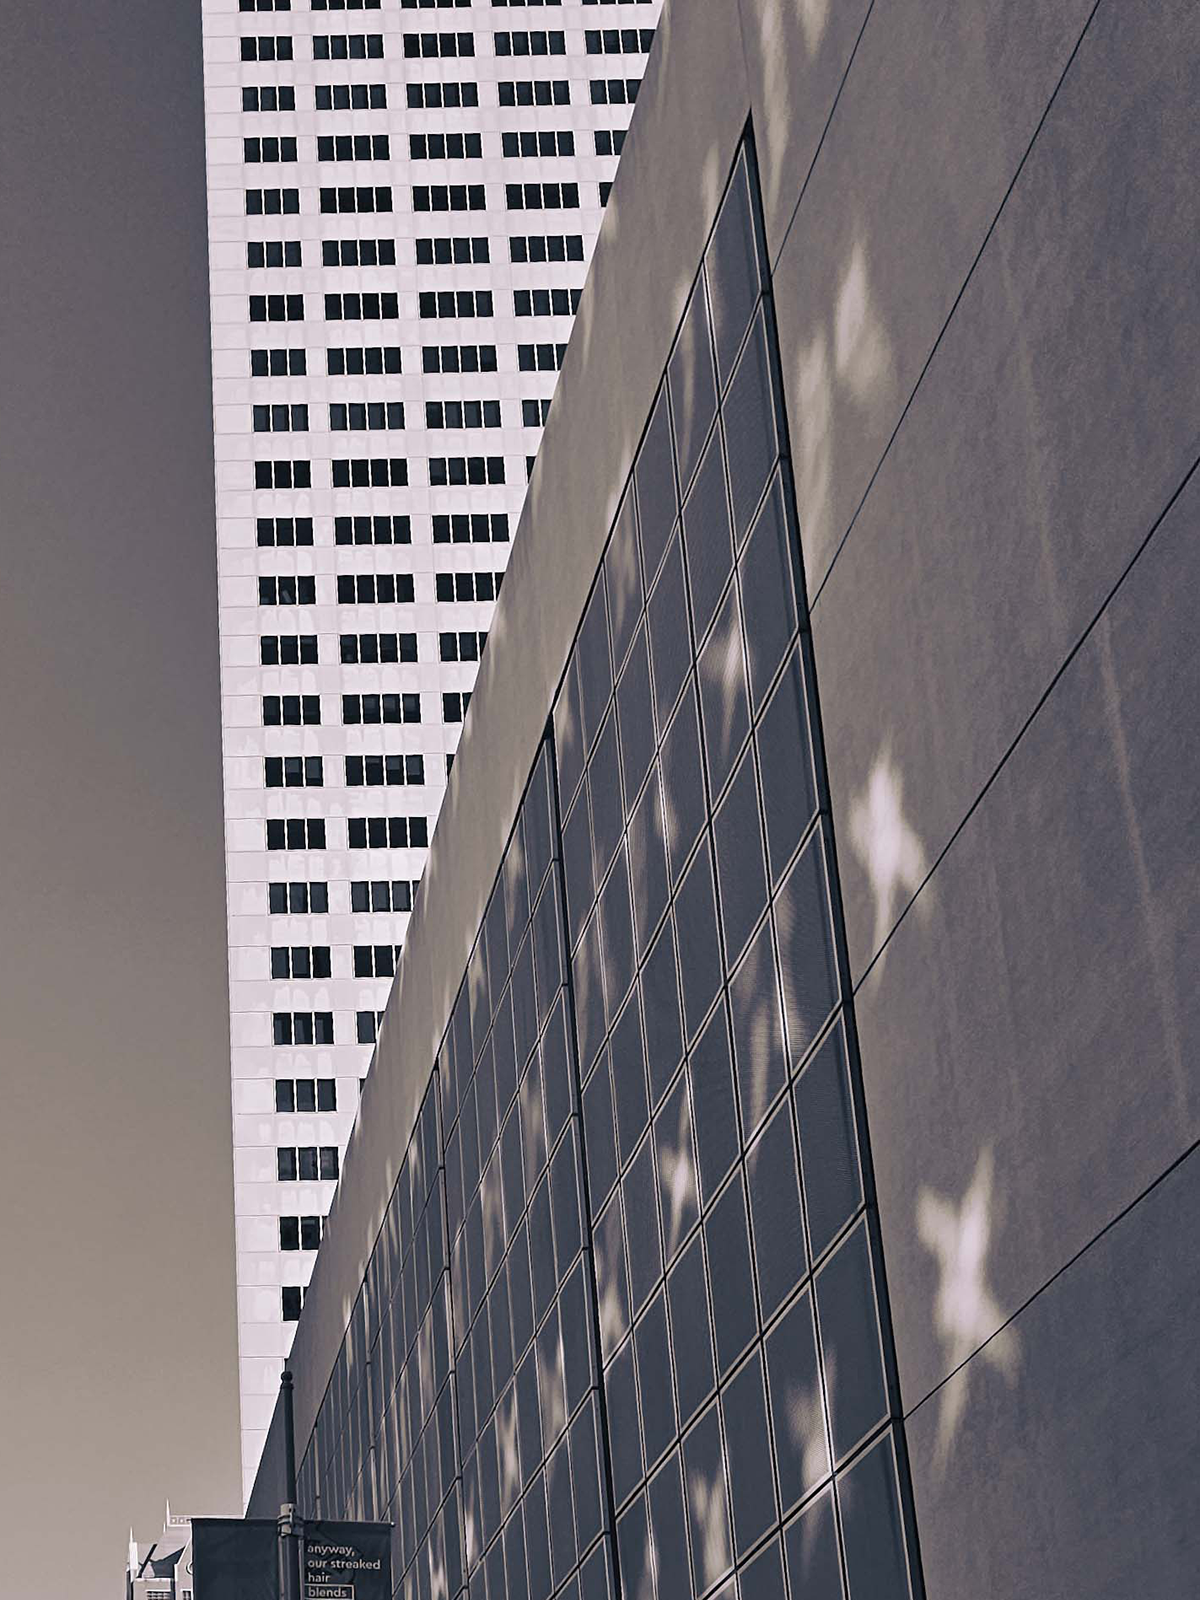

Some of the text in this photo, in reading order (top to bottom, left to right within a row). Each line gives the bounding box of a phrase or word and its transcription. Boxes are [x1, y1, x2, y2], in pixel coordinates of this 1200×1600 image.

[308, 1545, 355, 1556] anyway,
[308, 1560, 380, 1570] our streaked
[308, 1573, 331, 1583] hair
[309, 1587, 346, 1598] blends
